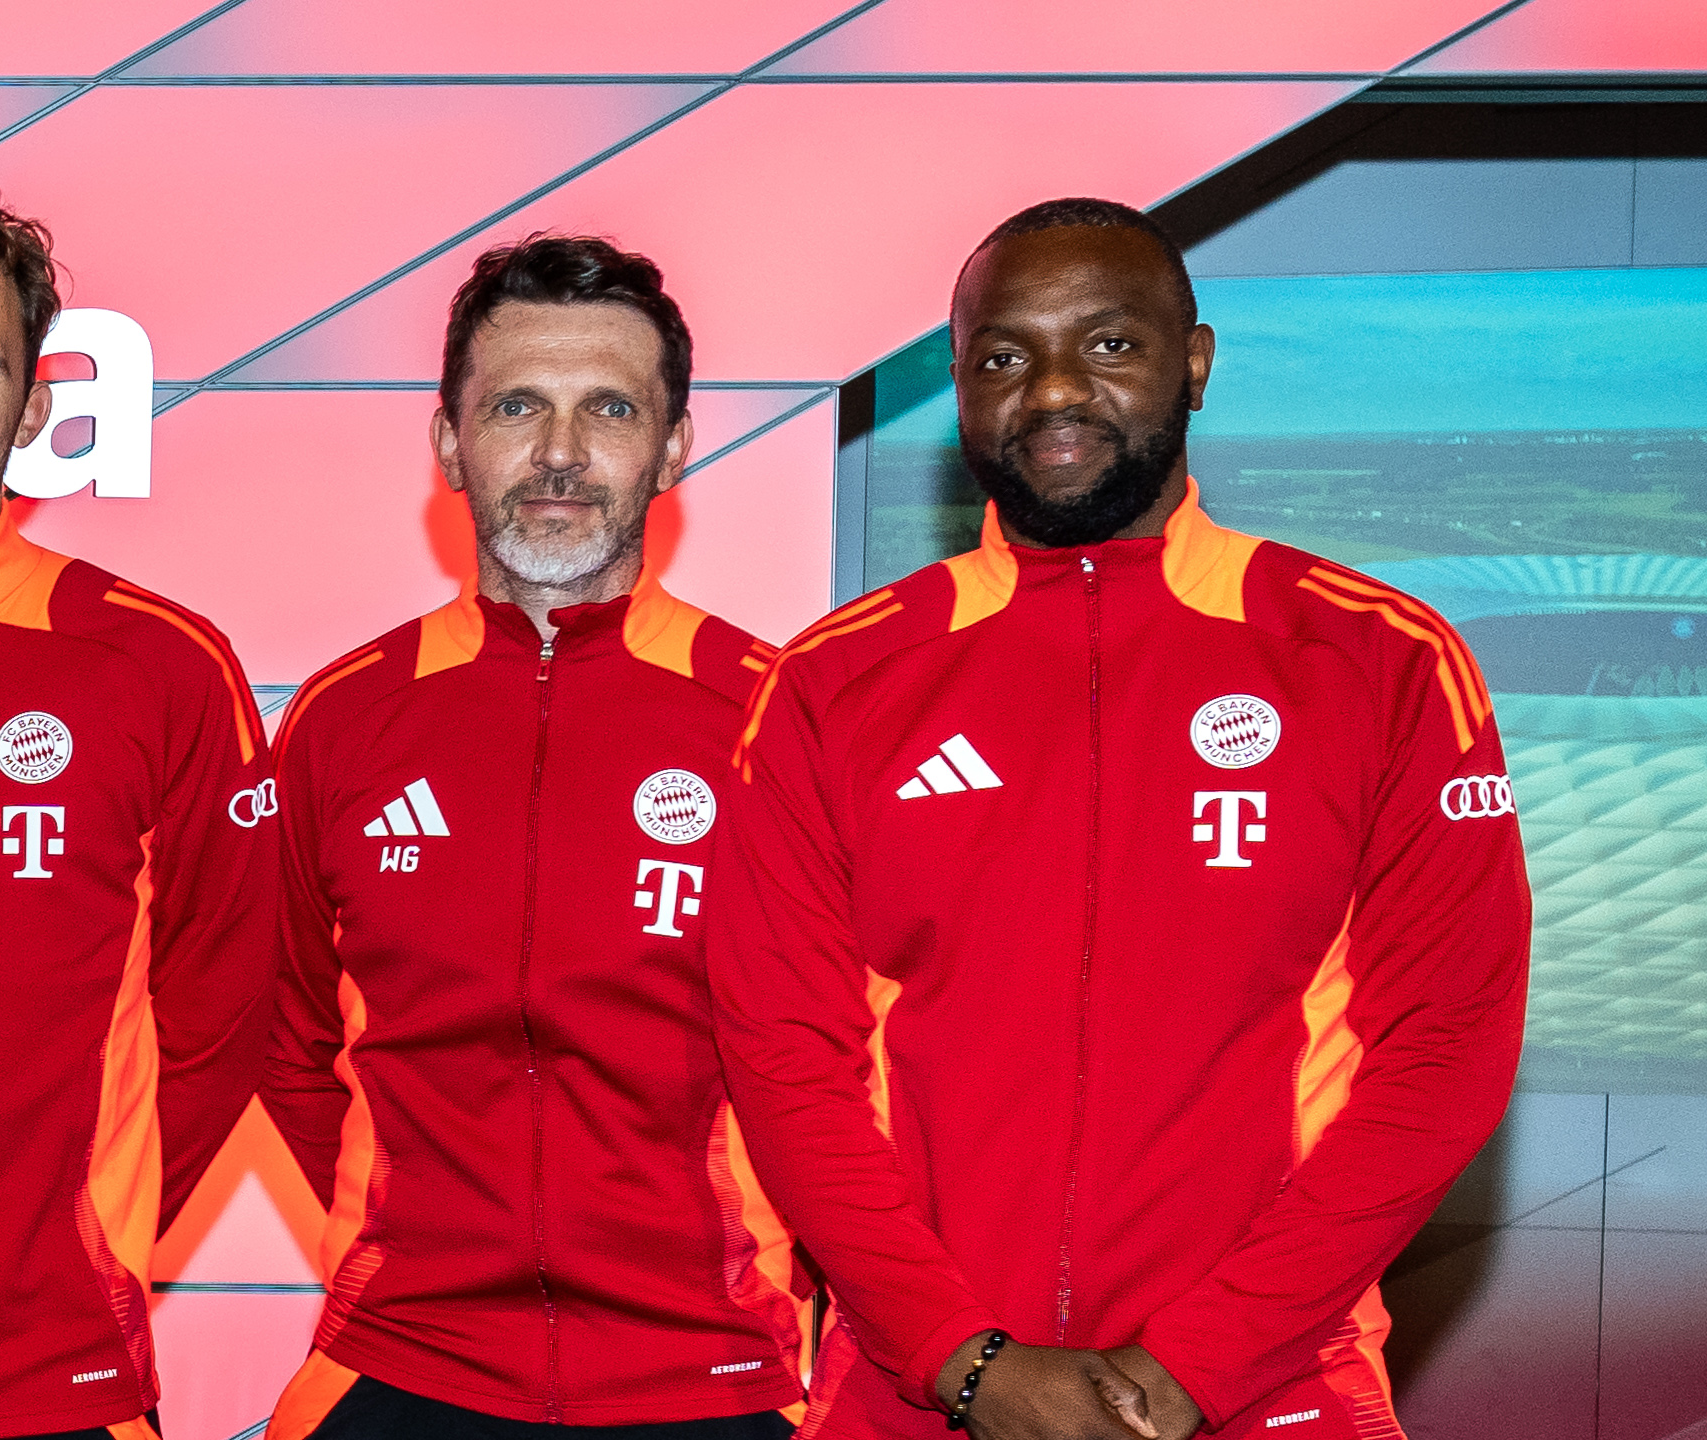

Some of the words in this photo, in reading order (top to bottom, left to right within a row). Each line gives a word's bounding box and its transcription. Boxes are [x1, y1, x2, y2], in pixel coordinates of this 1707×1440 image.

[1218, 700, 1272, 724] BAYERN
[18, 718, 65, 742] BAYERN
[660, 776, 708, 804] BAYERN
[380, 845, 420, 873] WG
